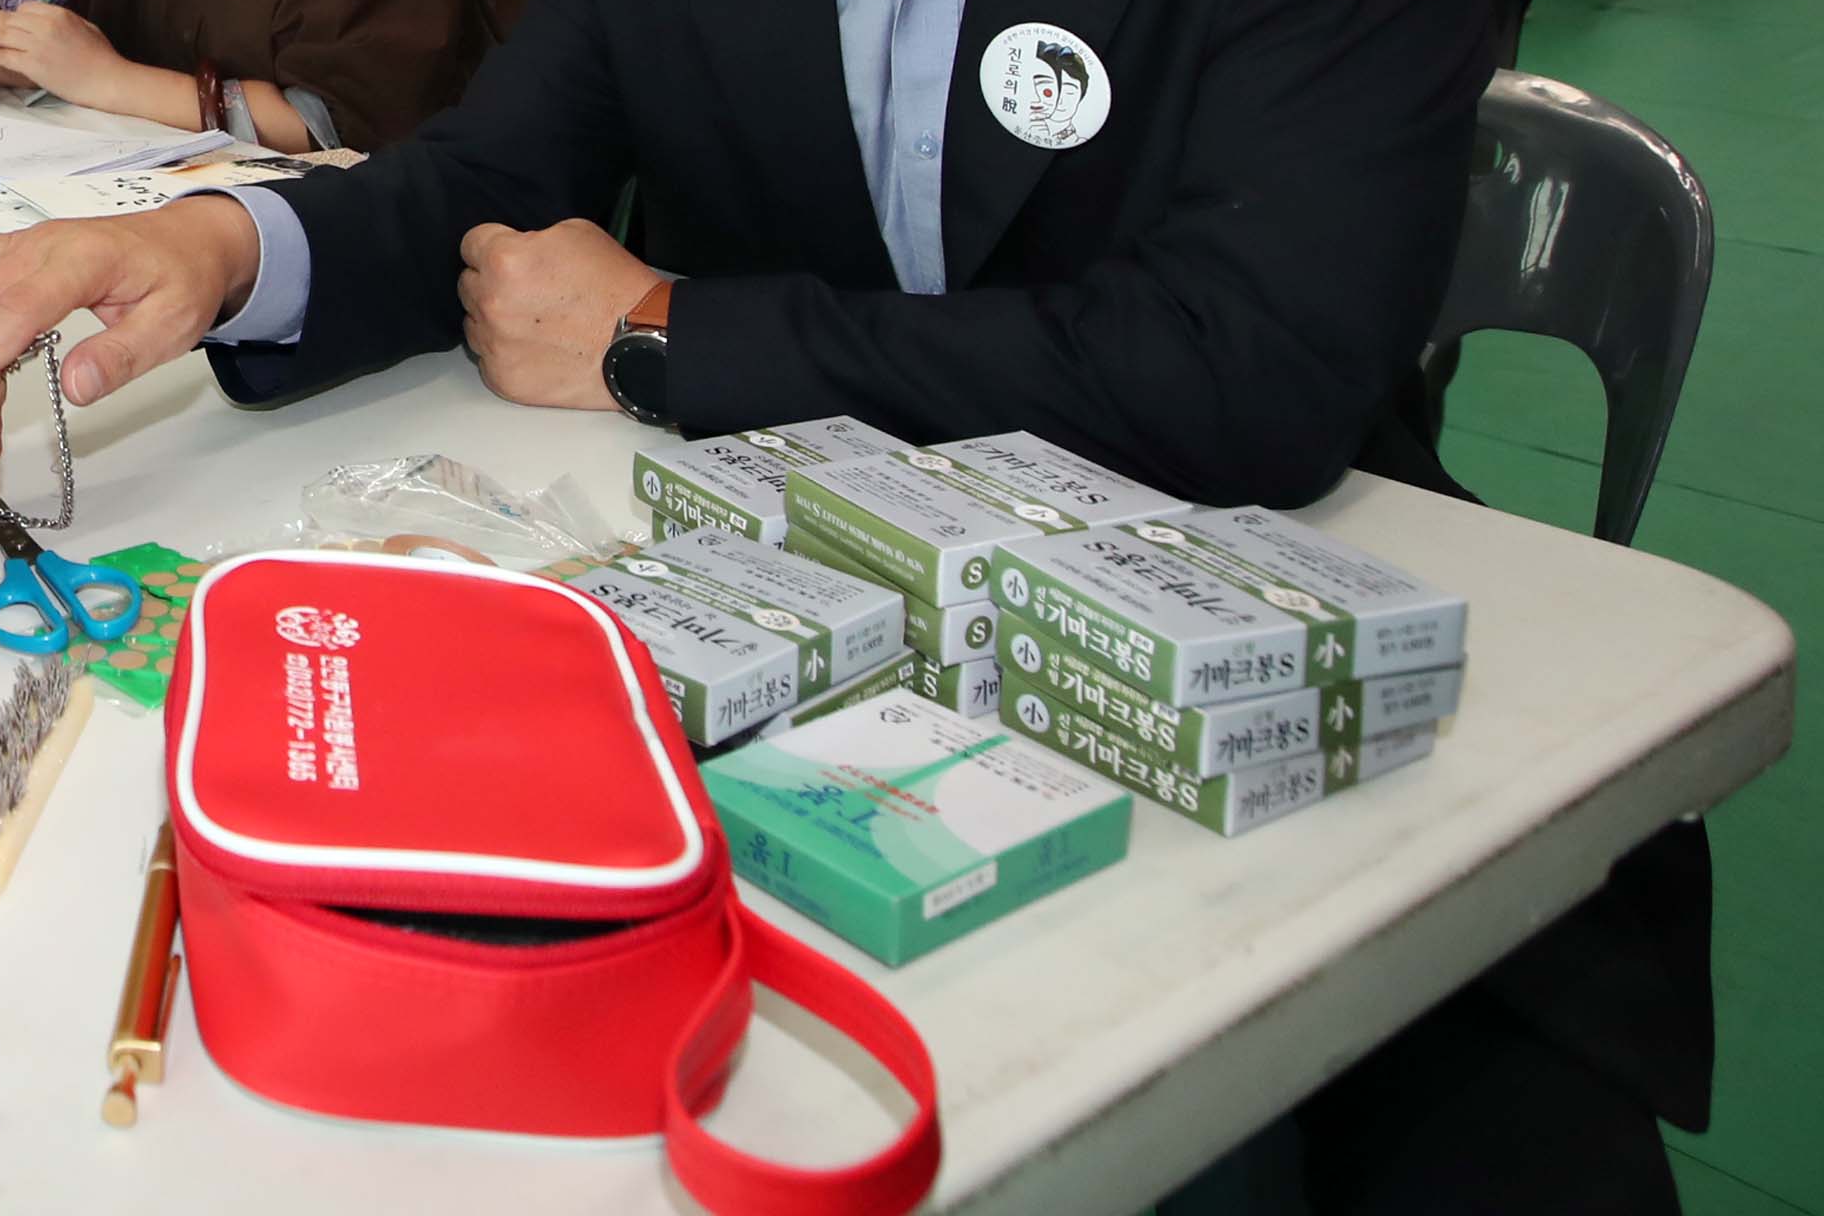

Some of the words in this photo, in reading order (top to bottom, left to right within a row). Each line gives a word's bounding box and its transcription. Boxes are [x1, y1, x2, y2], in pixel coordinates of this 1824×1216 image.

[968, 562, 984, 586] S
[1007, 574, 1024, 599] 小
[972, 621, 988, 646] S
[1047, 604, 1153, 682] 기마크봉S
[1314, 632, 1346, 670] 小
[805, 648, 826, 682] 小
[1017, 642, 1036, 666] 小
[1190, 652, 1296, 693] 기마크봉S
[718, 673, 792, 726] 기마크봉S
[1023, 701, 1044, 726] 小
[1062, 671, 1177, 753] 기마크봉S
[1327, 694, 1355, 733] 小
[1072, 730, 1200, 813] 기마크봉S
